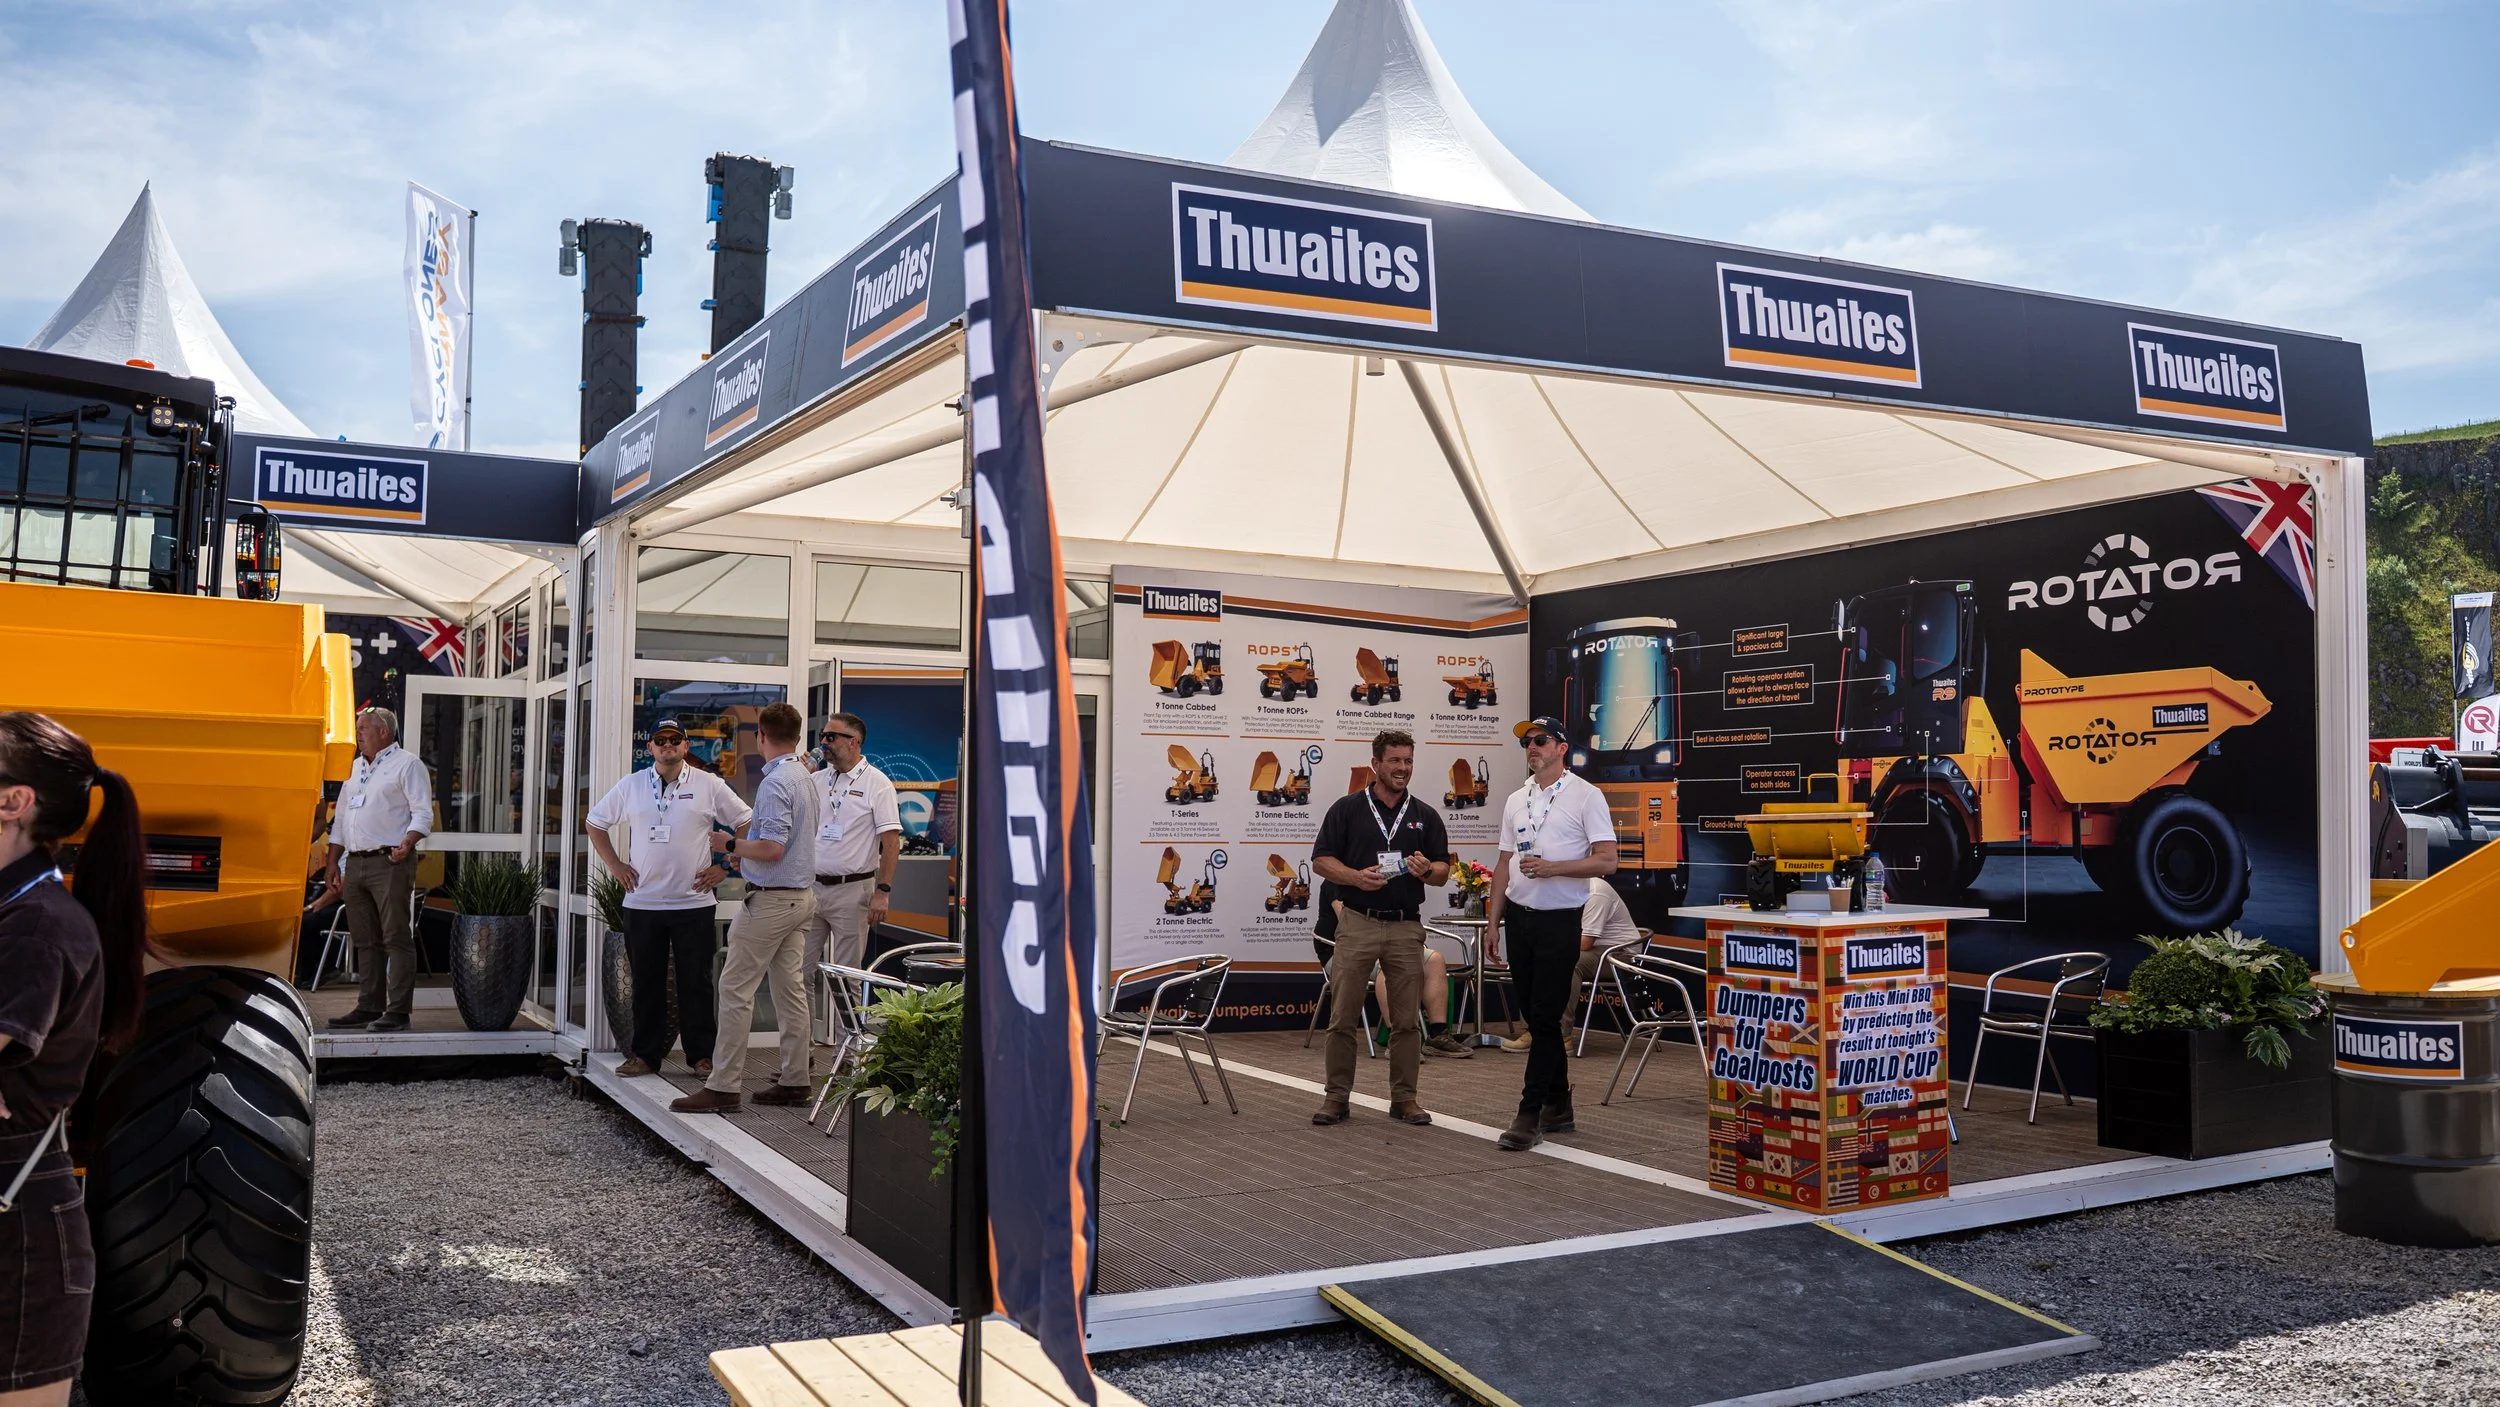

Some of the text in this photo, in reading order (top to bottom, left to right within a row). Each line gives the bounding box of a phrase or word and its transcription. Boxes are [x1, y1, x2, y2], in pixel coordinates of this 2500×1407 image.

[1188, 206, 1420, 293] Thwaites
[851, 241, 930, 331] Thwaites
[1729, 282, 1907, 355] Thwaites
[2137, 340, 2275, 403] Thwaites
[712, 356, 763, 421] Thwaites
[616, 428, 654, 480] Thwaites
[265, 459, 417, 504] Thwaites
[2008, 551, 2241, 611] ROTATOR
[1145, 590, 1218, 614] Thwaites
[1736, 630, 1784, 642] Significant large
[1247, 643, 1300, 657] ROPS+
[1585, 635, 1658, 655] ROTATOR
[1743, 642, 1769, 652] spacious
[1437, 654, 1485, 667] ROPS+
[1732, 670, 1805, 684] Rotating operator station
[1932, 679, 1957, 687] Thwaites
[1727, 687, 1745, 695] allows
[1746, 685, 1764, 693] driver
[1772, 683, 1794, 692] always
[1794, 681, 1810, 689] face
[1932, 687, 1957, 701] R9
[2024, 684, 2085, 697] PROTOTYPE
[1747, 695, 1774, 704] direction
[1774, 694, 1782, 702] of
[1782, 693, 1800, 701] travel
[1162, 702, 1184, 710] Tonne
[1185, 703, 1217, 711] Cabbed
[1263, 706, 1285, 714] Tonne
[1286, 707, 1309, 715] ROPS+
[1342, 710, 1362, 718] Tonne
[1364, 710, 1392, 719] Cabbed
[1393, 712, 1415, 721] Range
[1430, 713, 1500, 724] 6 Tonne ROPS+ Range
[2153, 707, 2207, 725] Thwaites
[1696, 732, 1767, 744] Best in class seat rotation
[2049, 731, 2157, 751] ROTATOR
[1745, 769, 1796, 778] Operator access
[1774, 780, 1791, 788] sides
[1171, 810, 1200, 818] T-Series
[1255, 811, 1310, 819] 3 Tonne Electric
[1449, 813, 1480, 821] 2.3 Tonne
[1648, 811, 1662, 821] R9
[1704, 820, 1743, 829] Ground-level
[1156, 917, 1213, 926] 2 Tonne Electric
[1256, 916, 1308, 925] 2 Tonne Range
[1728, 940, 1795, 967] Thwaites
[1849, 944, 1921, 968] Thwaites
[1717, 985, 1806, 1024] Dumpers
[1843, 987, 1931, 1010] Win this Mini BBQ
[1842, 1009, 1932, 1034] by predicting the
[1735, 1019, 1765, 1051] for
[1839, 1030, 1936, 1053] result of tonight's
[2336, 1023, 2455, 1062] Thwaites
[1714, 1047, 1815, 1091] Goalposts
[1838, 1050, 1939, 1087] WORLD CUP
[1864, 1087, 1913, 1106] matches.
